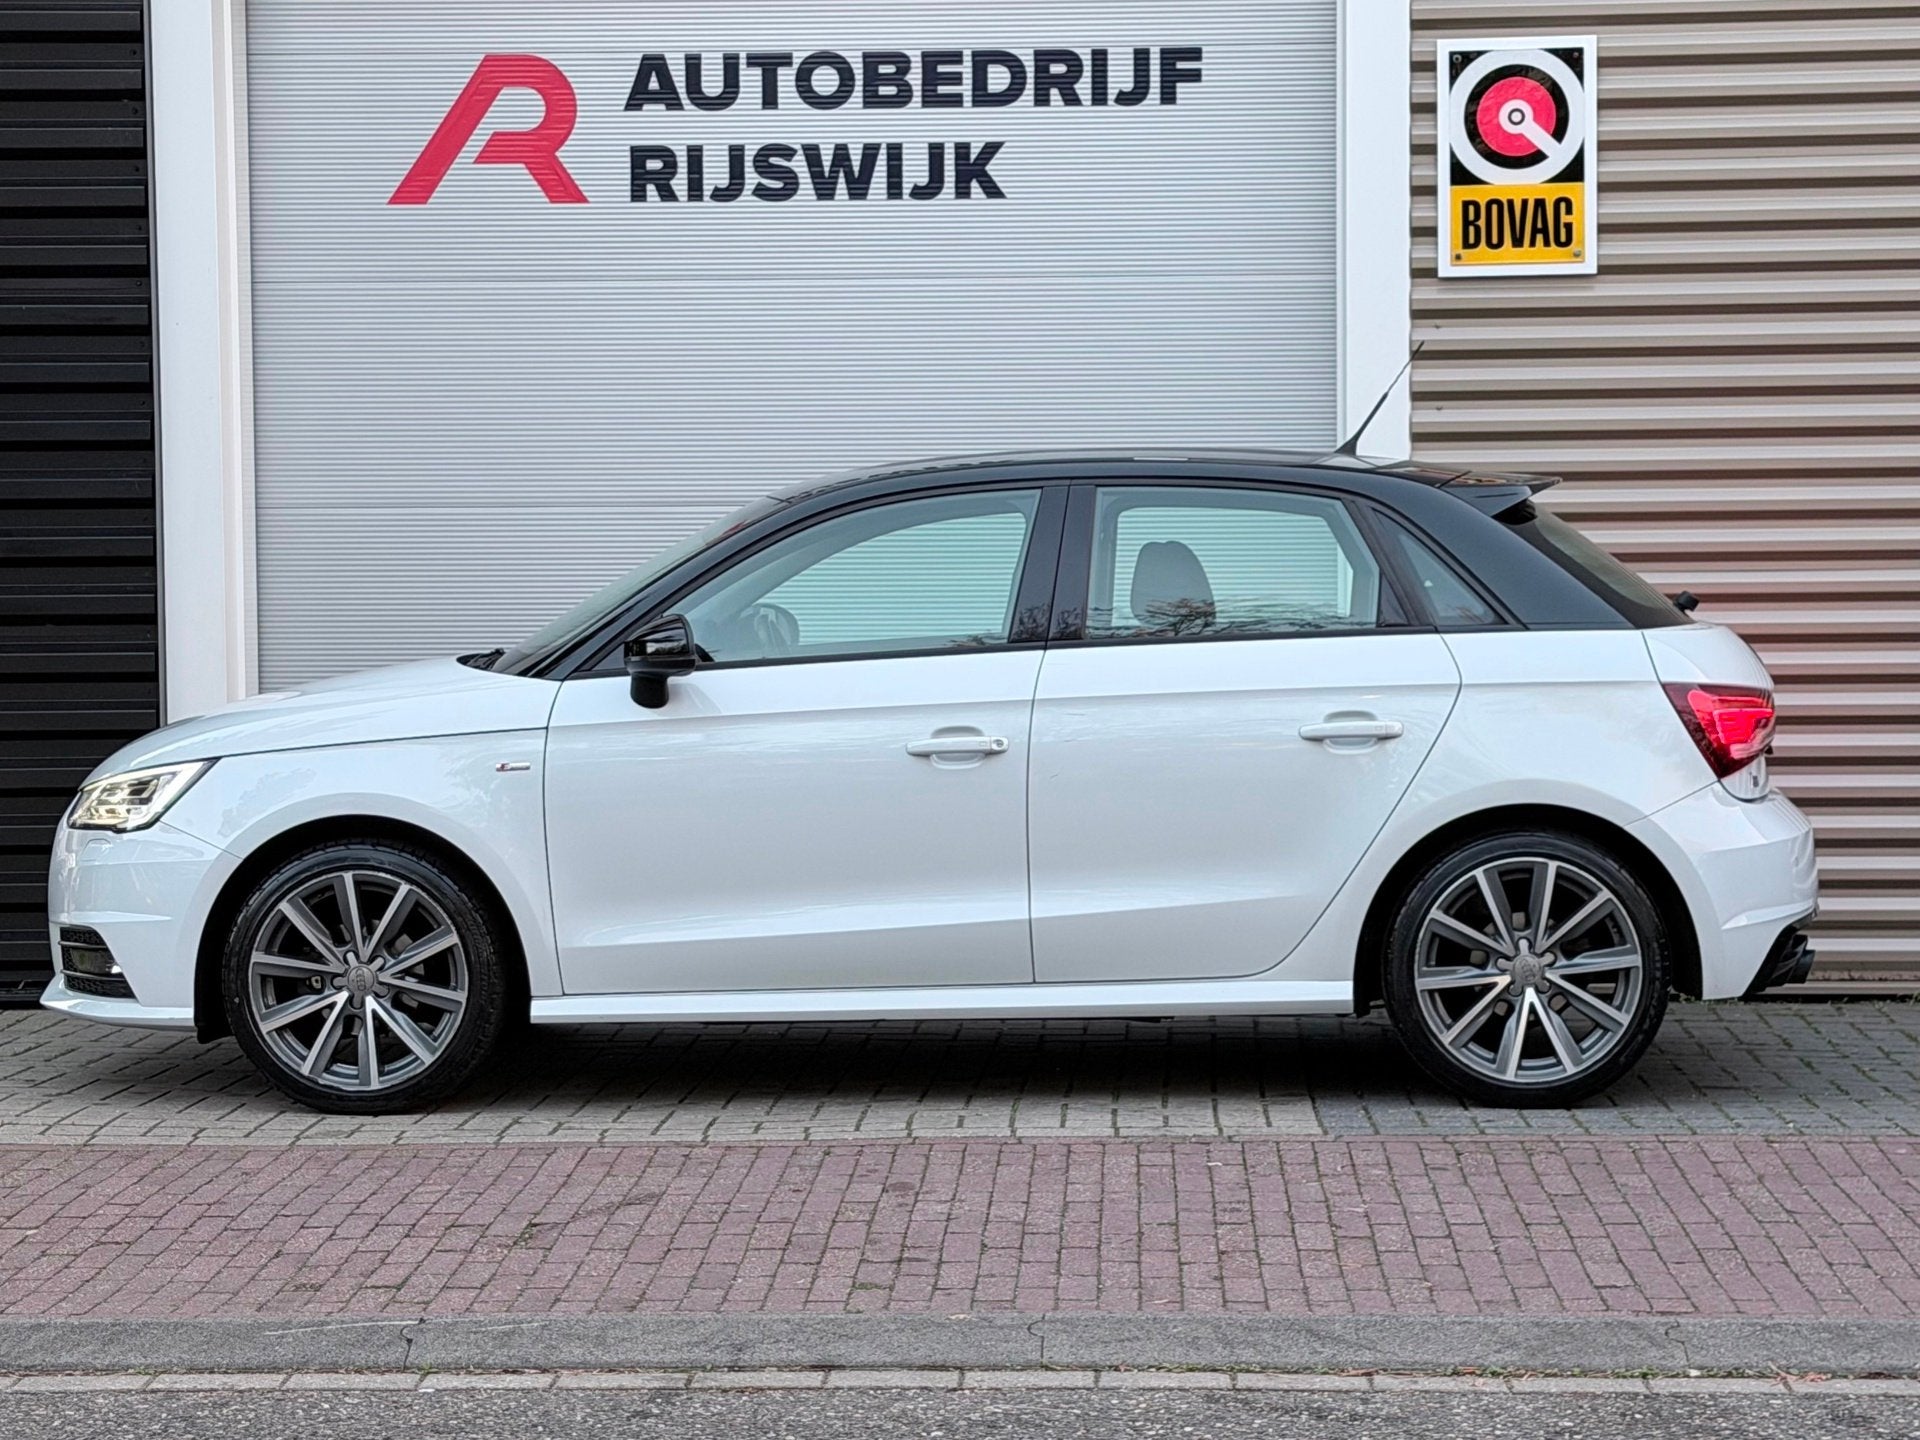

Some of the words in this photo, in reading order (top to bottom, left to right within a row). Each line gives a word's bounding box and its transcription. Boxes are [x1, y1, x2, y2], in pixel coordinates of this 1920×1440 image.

[624, 47, 1203, 111] AUTOBEDRIJF
[629, 141, 1008, 203] RIJSWIJK
[1462, 196, 1573, 249] BOVAG
